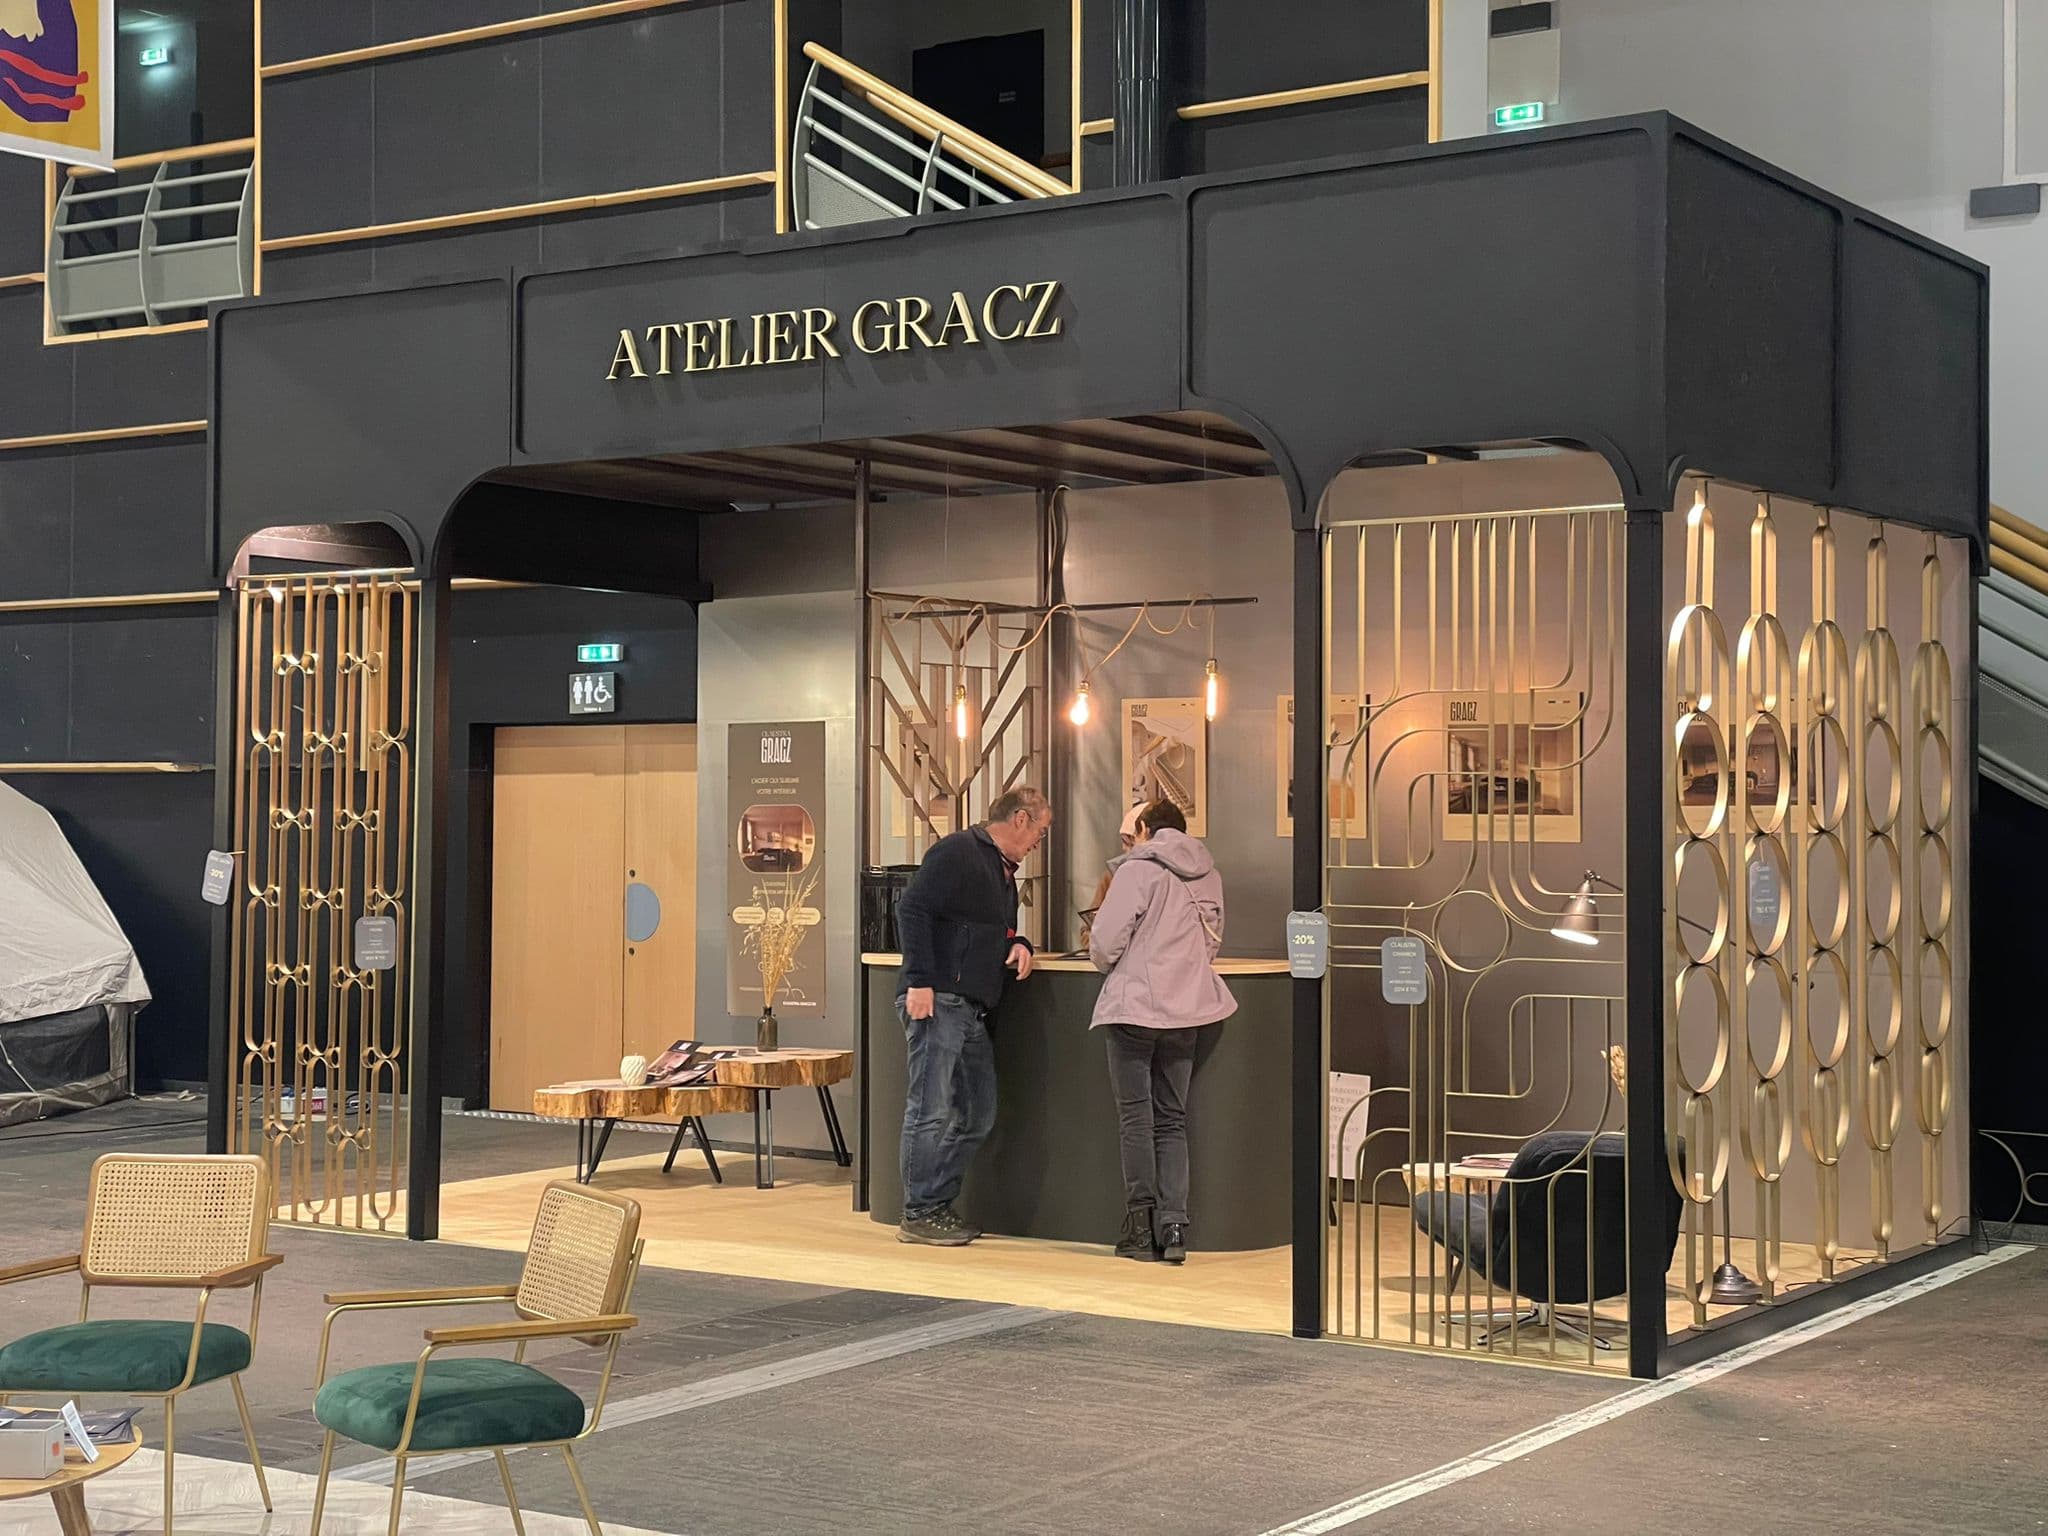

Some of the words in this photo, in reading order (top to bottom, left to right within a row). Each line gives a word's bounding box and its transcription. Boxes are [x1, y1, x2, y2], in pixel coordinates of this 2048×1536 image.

[604, 307, 841, 380] ATELIER
[850, 280, 1062, 354] GRACZ
[1450, 701, 1478, 721] GRACZ
[761, 737, 792, 763] GRACZ
[1292, 934, 1316, 945] -20%
